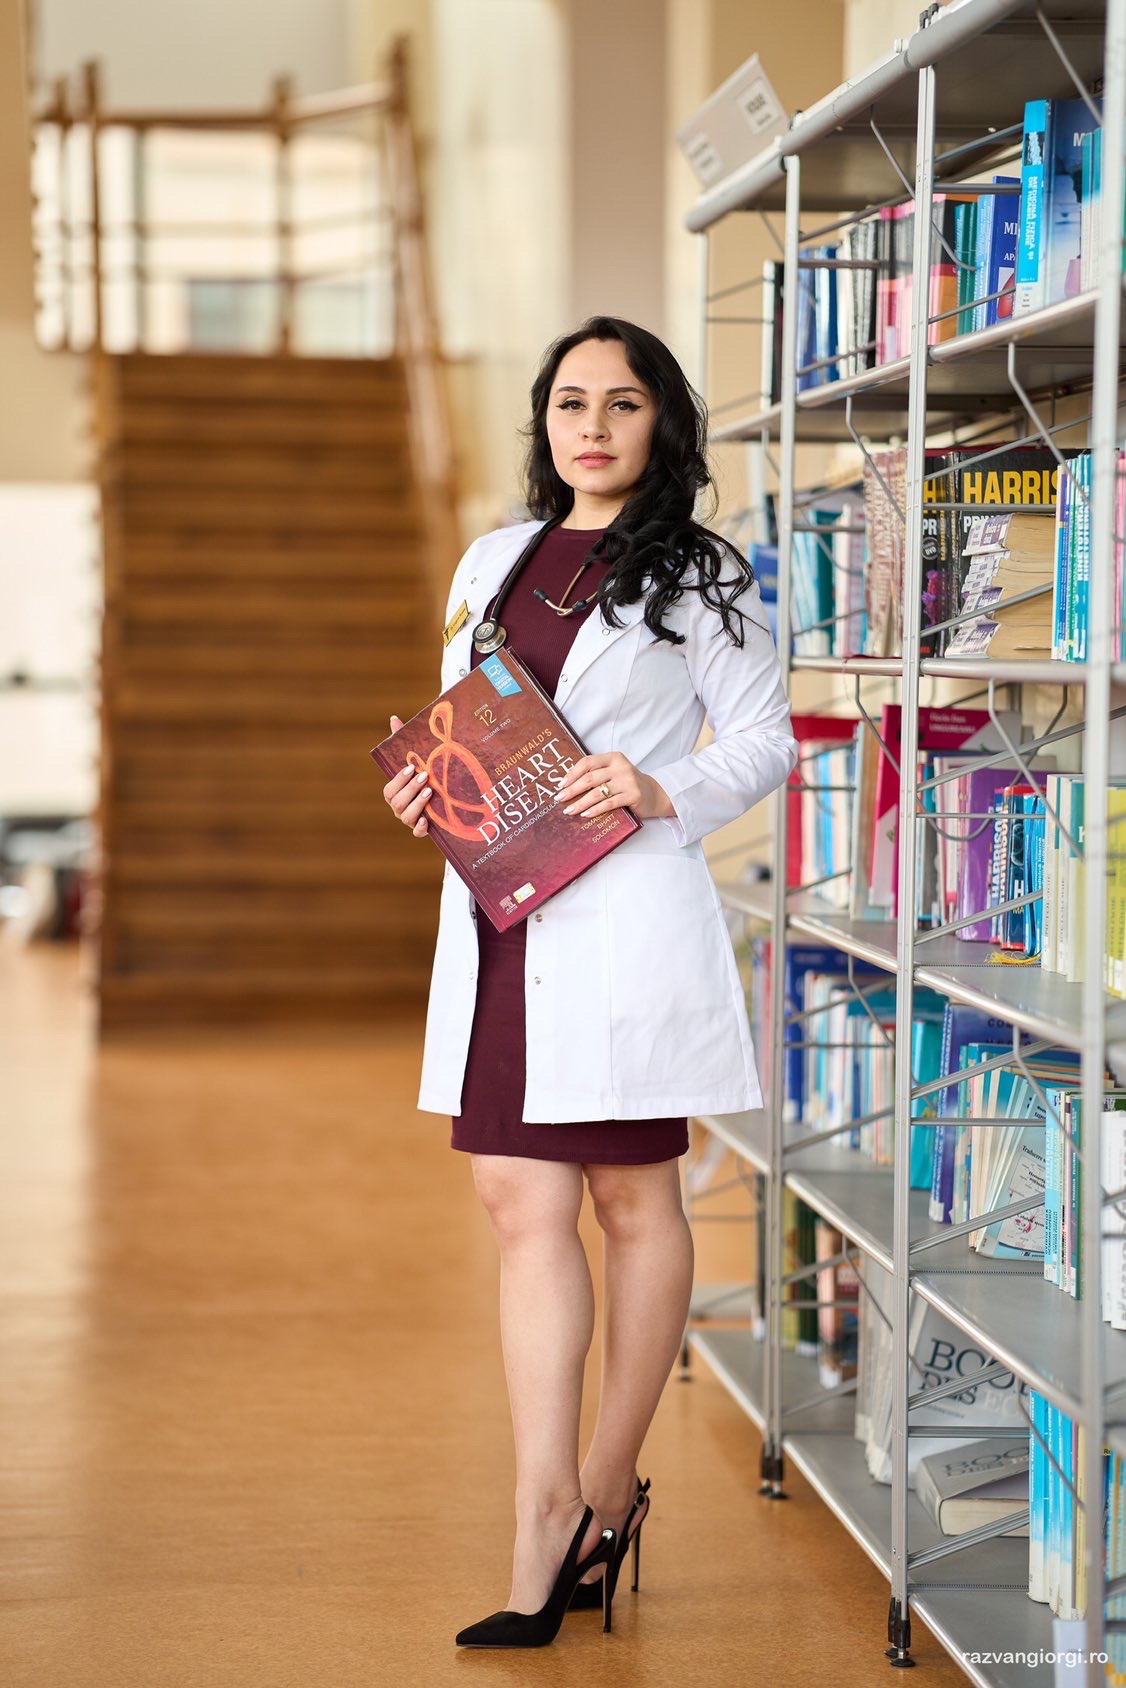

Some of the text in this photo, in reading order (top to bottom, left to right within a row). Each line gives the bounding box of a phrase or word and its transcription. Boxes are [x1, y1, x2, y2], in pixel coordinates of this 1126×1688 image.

[494, 674, 510, 686] DIGITAL
[474, 703, 489, 716] EDITION
[478, 708, 497, 728] 12
[481, 718, 511, 743] VOLUME TWO
[494, 727, 553, 776] BRAUNWALD'S
[480, 737, 568, 814] HEART
[591, 819, 620, 843] SOLOMON
[596, 813, 615, 829] BHATT
[477, 841, 506, 865] TEXTBOOK
[505, 834, 514, 843] OF
